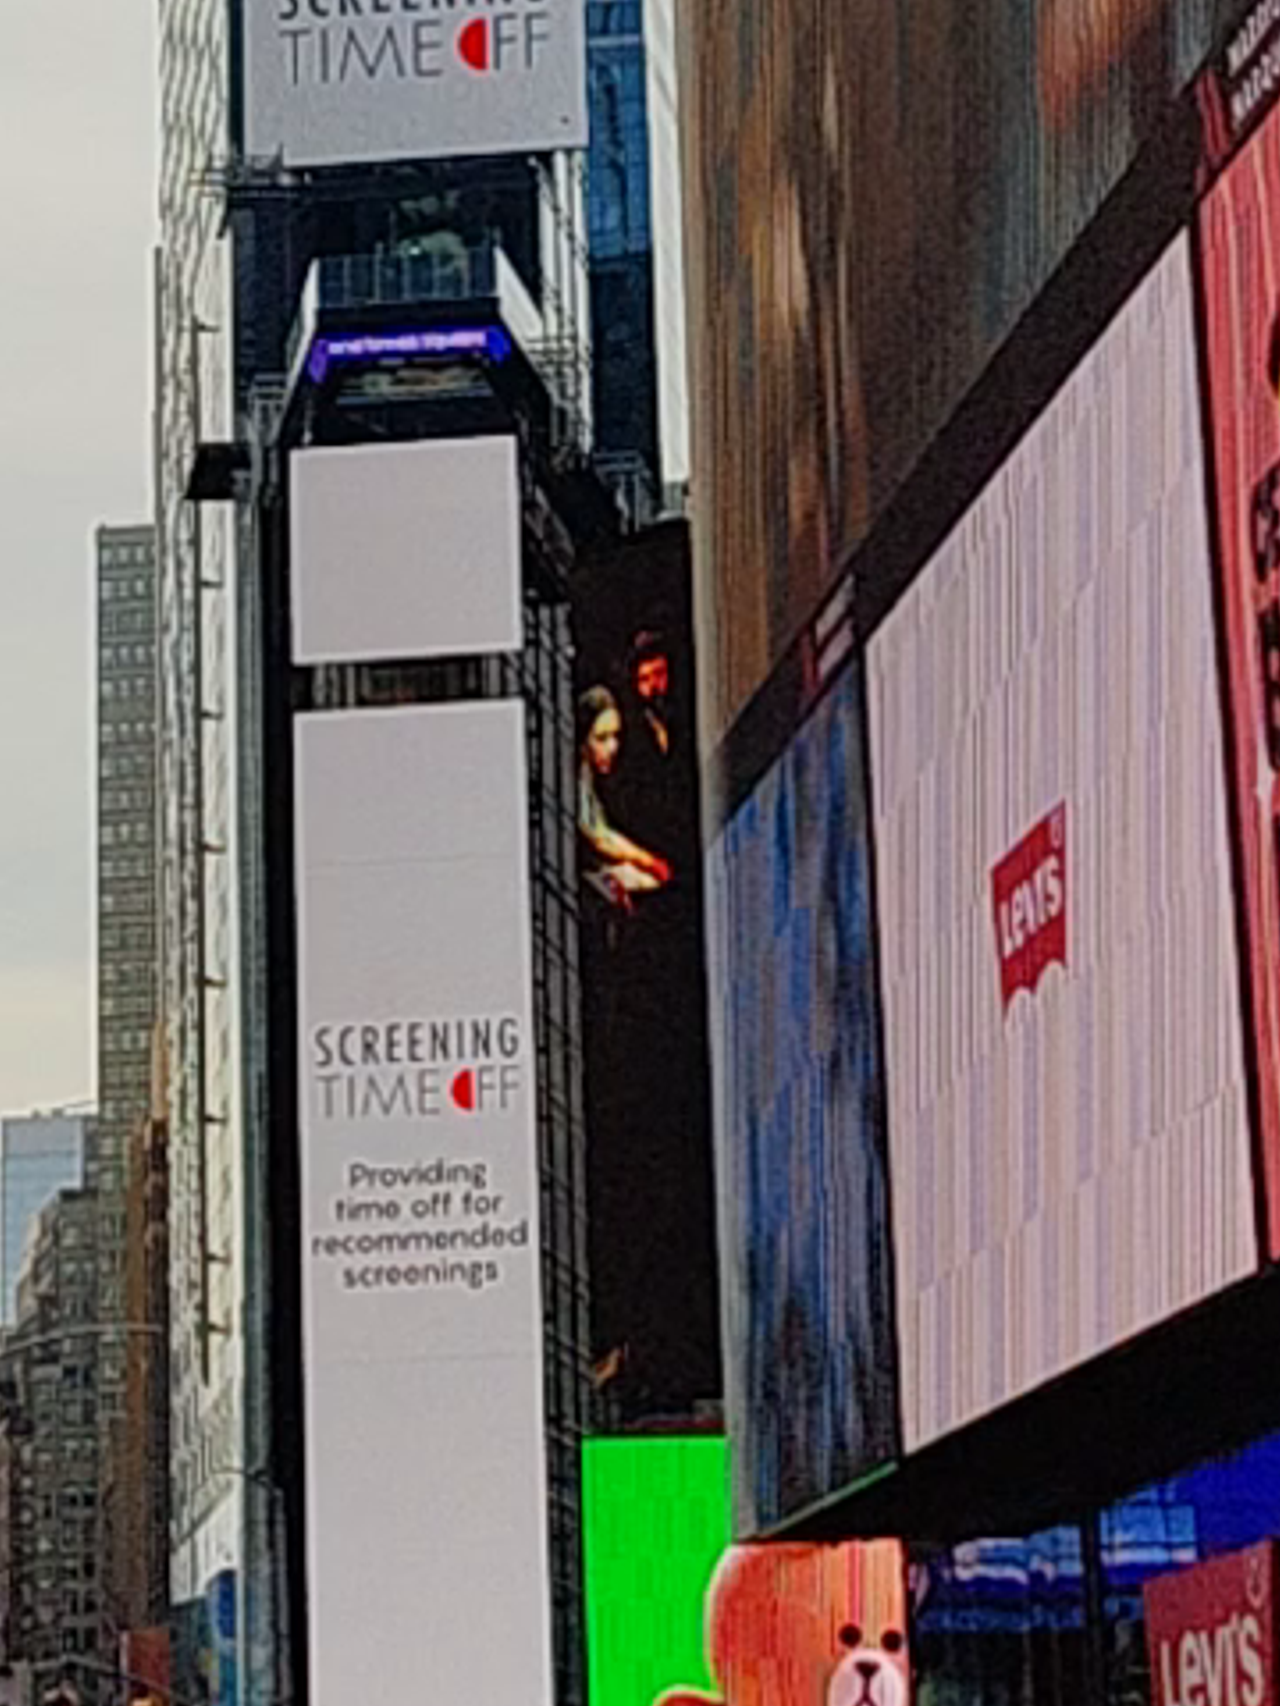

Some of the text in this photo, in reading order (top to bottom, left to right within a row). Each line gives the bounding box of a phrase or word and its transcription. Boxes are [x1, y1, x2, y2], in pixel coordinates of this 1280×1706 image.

[279, 18, 444, 86] TIME
[313, 1017, 521, 1069] SCREENING
[315, 1068, 442, 1120] TIME
[348, 1158, 488, 1191] Providing
[335, 1191, 504, 1223] time off for
[311, 1220, 531, 1256] recommended
[341, 1259, 499, 1291] screenings
